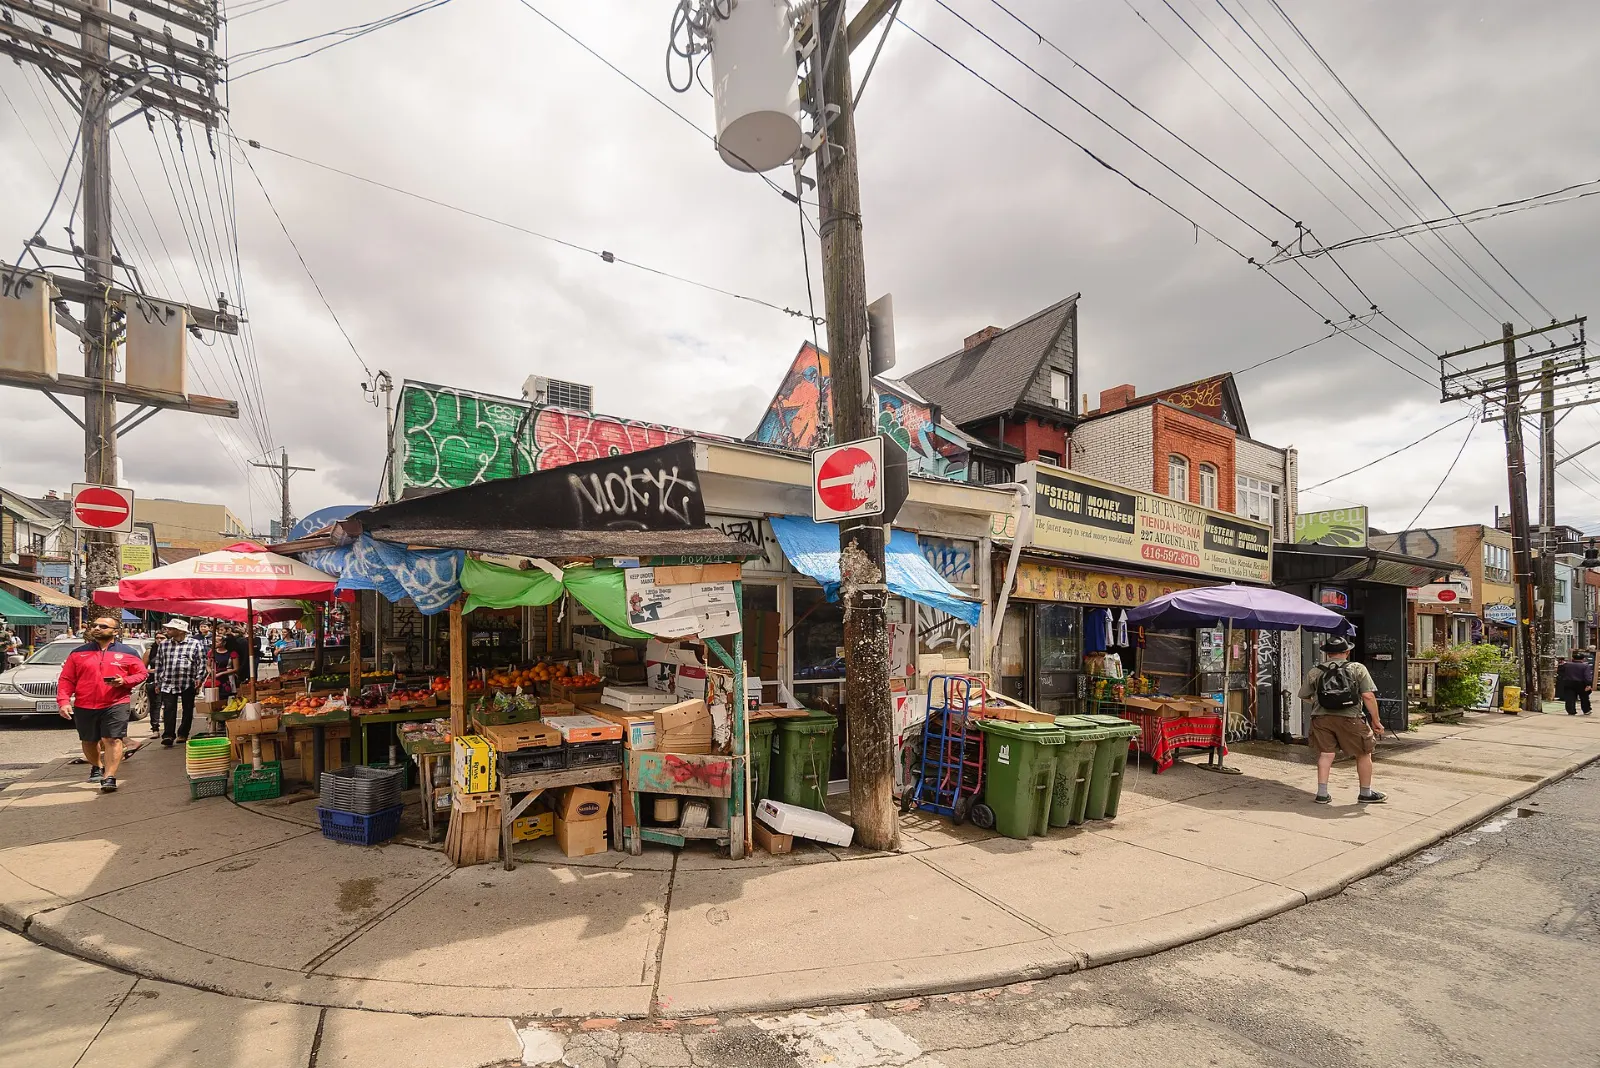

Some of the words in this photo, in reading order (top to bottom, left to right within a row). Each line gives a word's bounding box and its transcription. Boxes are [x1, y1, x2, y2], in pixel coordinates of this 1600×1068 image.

[1036, 482, 1081, 502] WESTERN
[1049, 497, 1080, 514] UNION
[1088, 495, 1120, 512] MONEY
[1136, 495, 1149, 513] EL
[1151, 499, 1176, 519] BUEN
[1177, 506, 1207, 527] PRECIO
[1087, 506, 1134, 525] TRANSFER
[1035, 518, 1045, 530] The
[1062, 527, 1073, 538] way
[1074, 528, 1080, 536] to
[1080, 529, 1092, 539] send
[1093, 534, 1108, 544] money
[1140, 515, 1171, 532] TIENDA
[1172, 523, 1201, 540] HISPANA
[1205, 523, 1235, 538] WESTERN
[1140, 529, 1154, 541] 227
[1154, 532, 1186, 549] AUGUSTA
[1186, 540, 1200, 552] AVE.
[1212, 534, 1234, 546] UNION
[1238, 531, 1257, 543] DINERO
[1238, 539, 1245, 549] EN
[1245, 541, 1269, 554] MINUTOS
[1143, 545, 1199, 567] 416-597-8716
[202, 564, 286, 574] SLEEMAN
